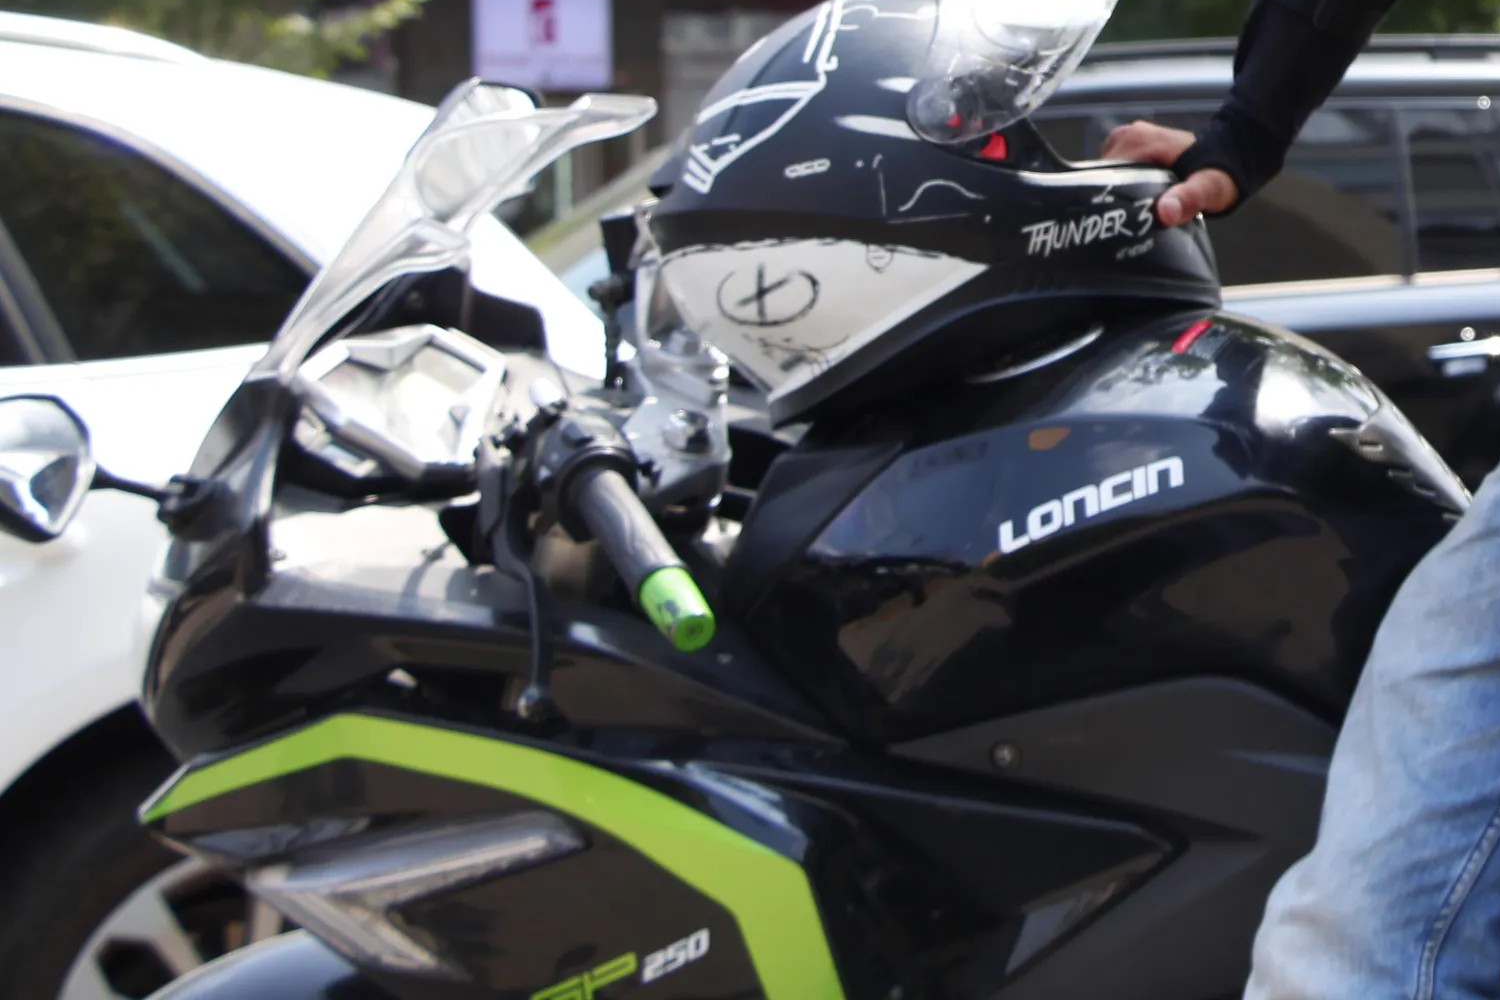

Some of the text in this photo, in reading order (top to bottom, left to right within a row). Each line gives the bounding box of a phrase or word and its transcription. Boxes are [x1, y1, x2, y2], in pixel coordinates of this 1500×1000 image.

[1020, 208, 1134, 259] THUNDER
[1133, 197, 1154, 237] 3
[641, 927, 711, 985] 250
